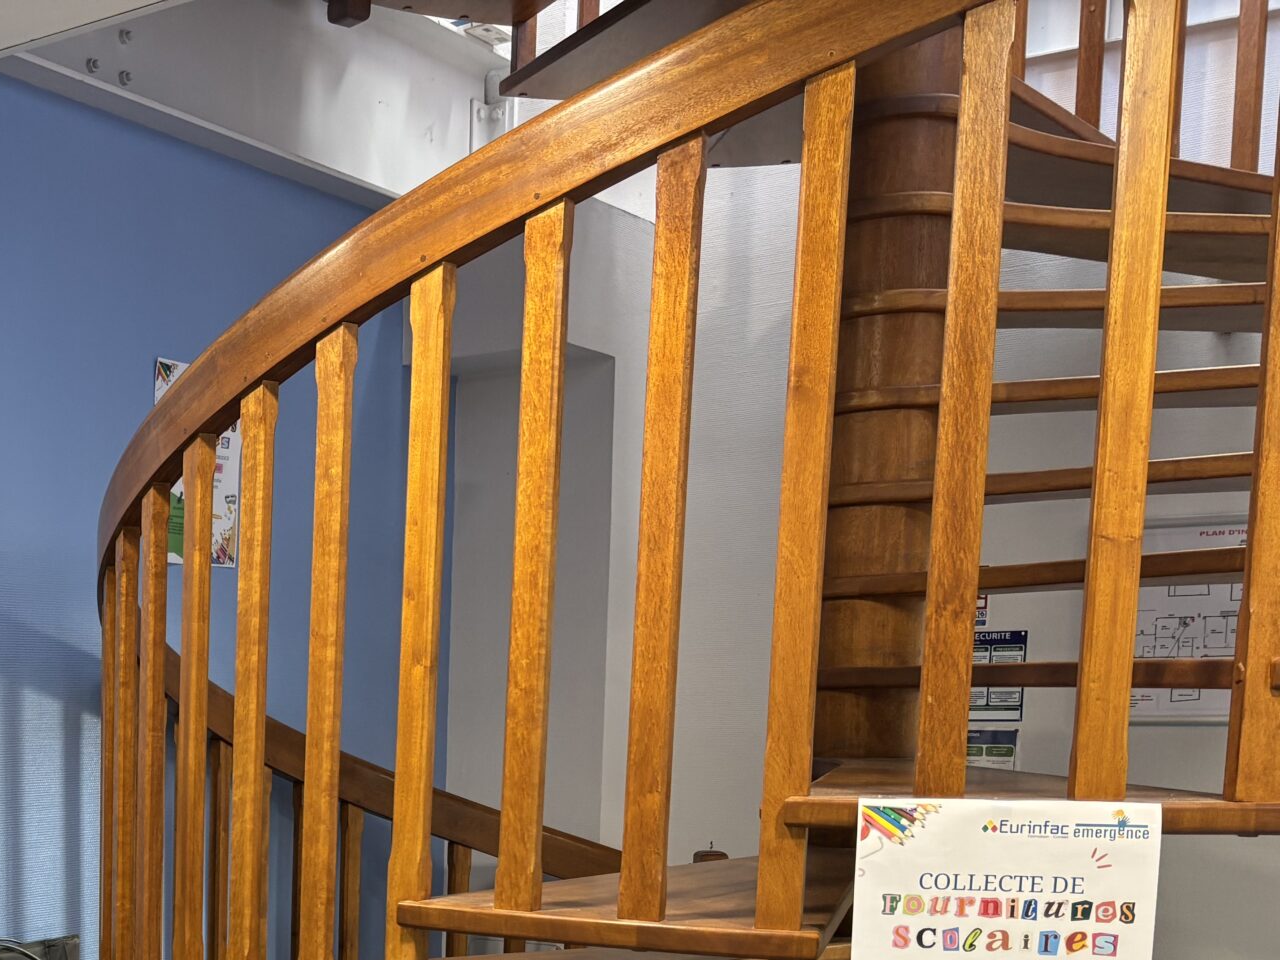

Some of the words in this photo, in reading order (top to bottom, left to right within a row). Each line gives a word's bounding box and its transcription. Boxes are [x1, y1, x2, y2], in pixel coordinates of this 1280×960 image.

[974, 632, 1011, 640] ECURITE
[999, 819, 1069, 835] Eurinfac
[1073, 827, 1150, 842] emergence
[919, 872, 1044, 893] COLLECTE
[1052, 876, 1085, 894] DE
